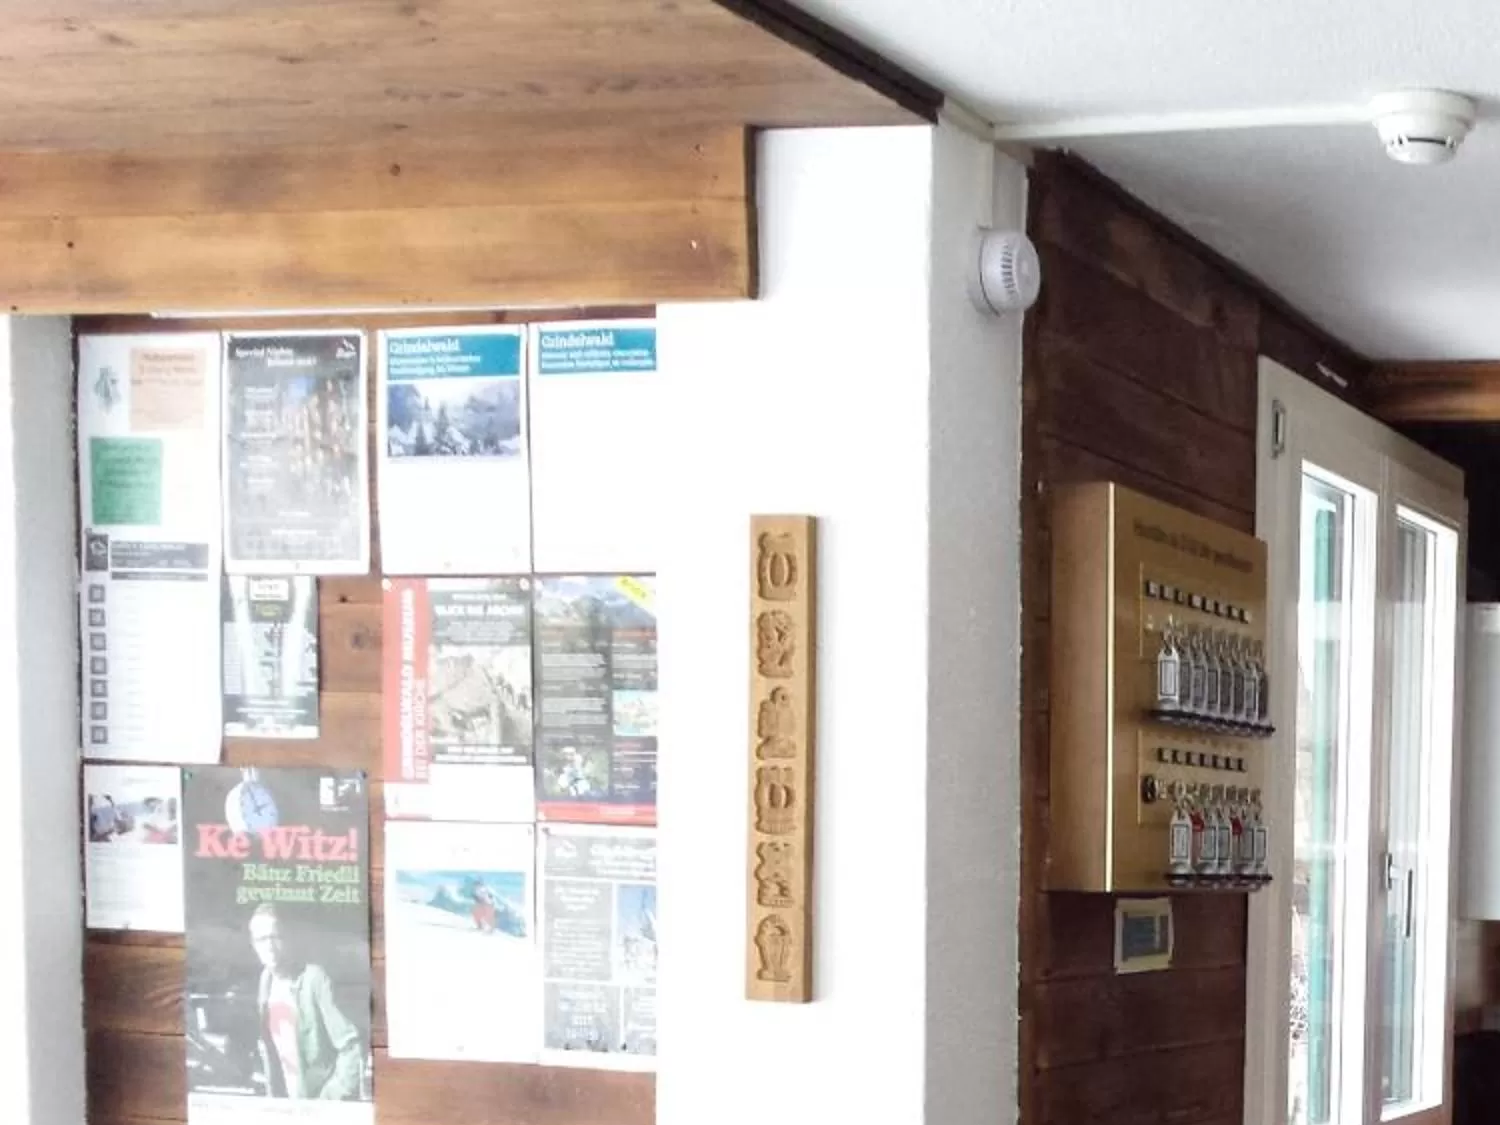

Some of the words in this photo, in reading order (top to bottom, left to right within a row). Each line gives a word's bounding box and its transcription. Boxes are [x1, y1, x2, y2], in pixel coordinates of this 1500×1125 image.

[195, 824, 250, 859] Ke
[257, 825, 358, 862] Witz!
[236, 884, 315, 904] gewinnt
[319, 886, 360, 904] Zeit
